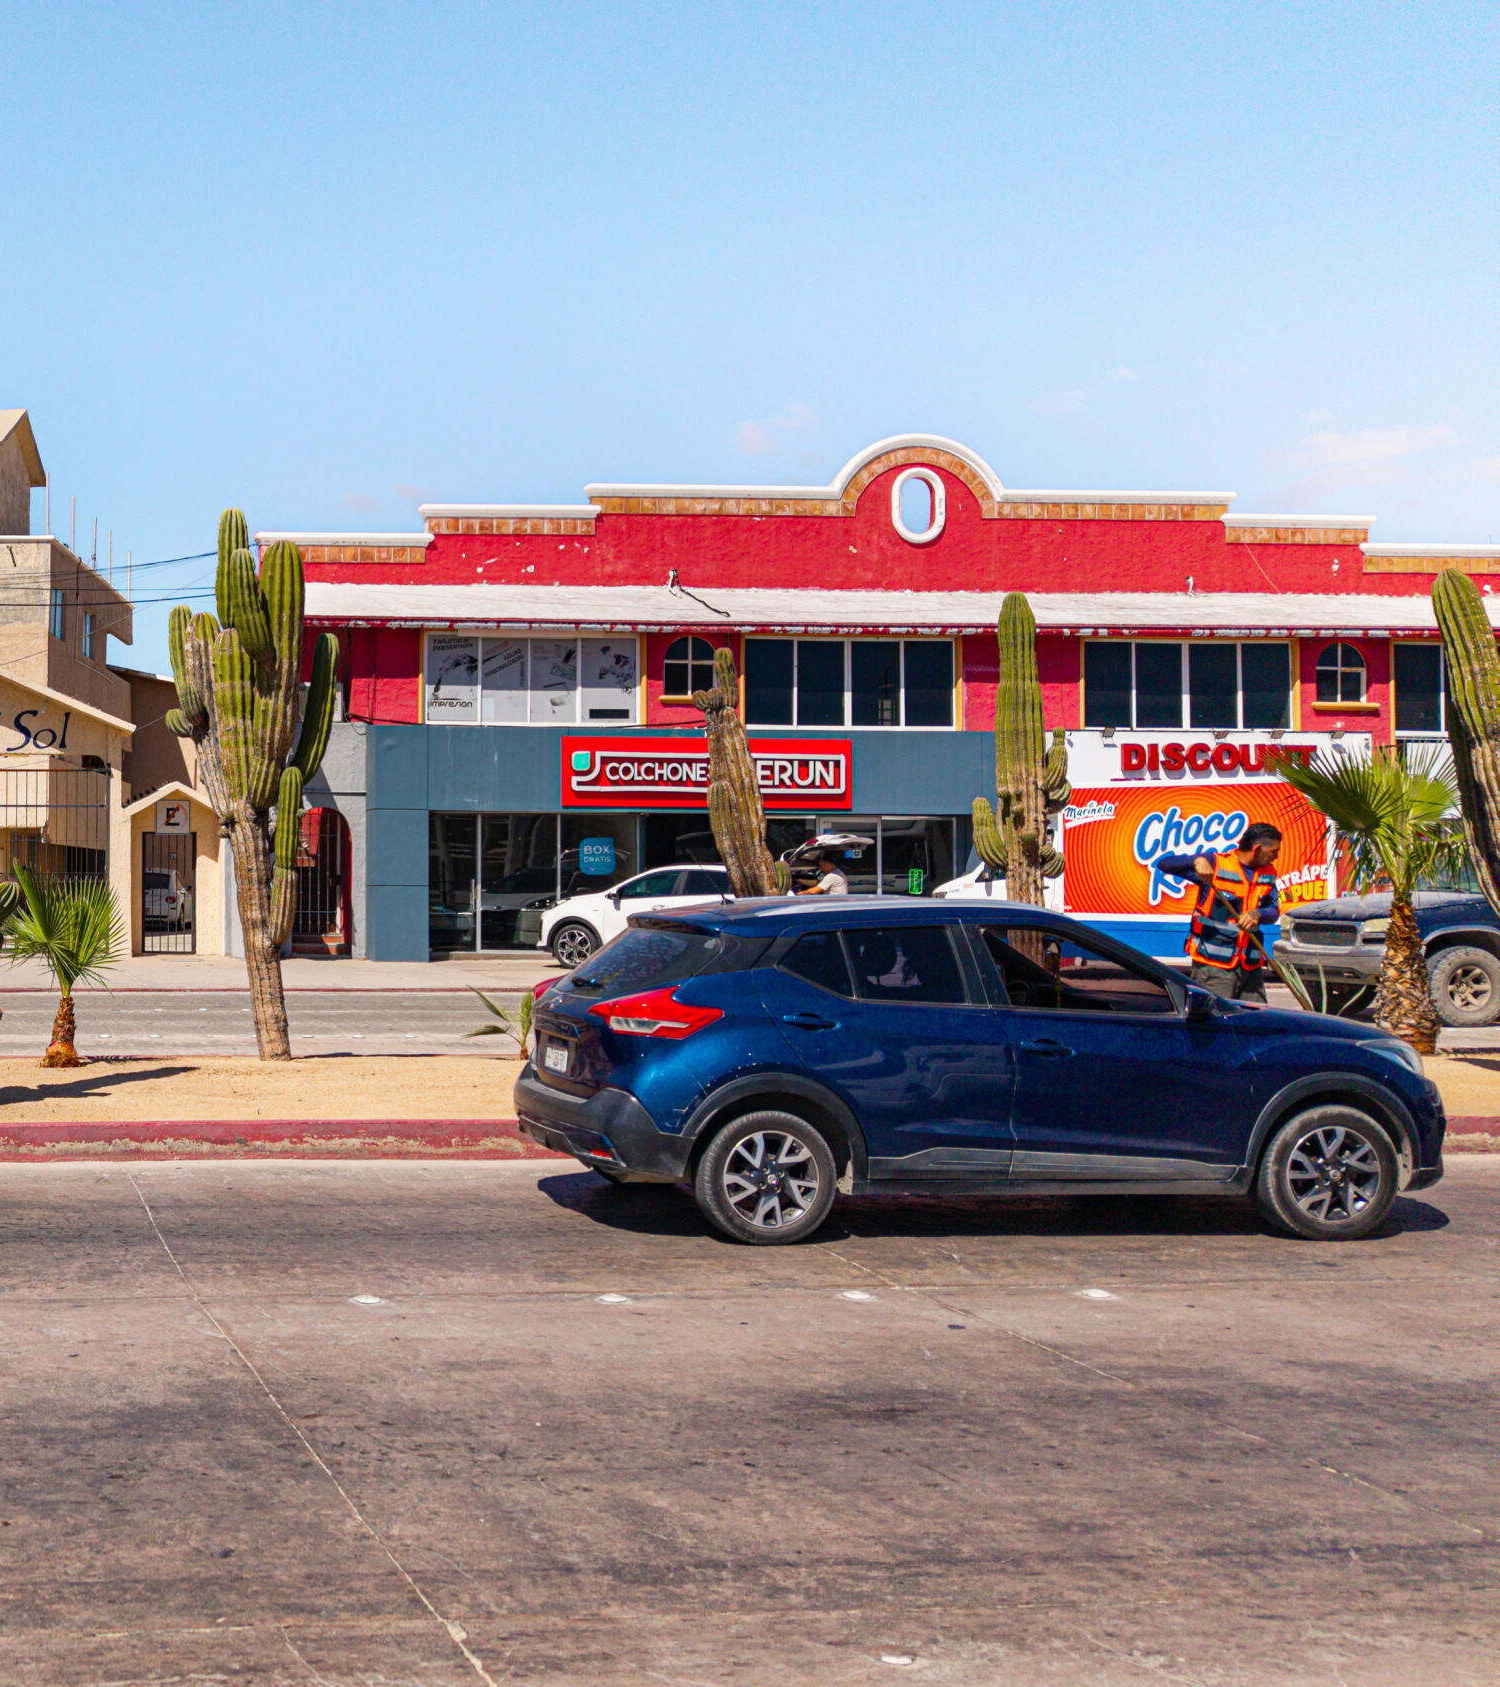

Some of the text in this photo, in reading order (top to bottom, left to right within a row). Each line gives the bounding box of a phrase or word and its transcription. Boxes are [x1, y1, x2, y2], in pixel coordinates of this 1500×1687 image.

[6, 710, 71, 751] Sol
[756, 760, 834, 787] ERUN
[1064, 802, 1113, 819] Marinela
[1136, 808, 1246, 860] Choco
[583, 845, 610, 855] BOX
